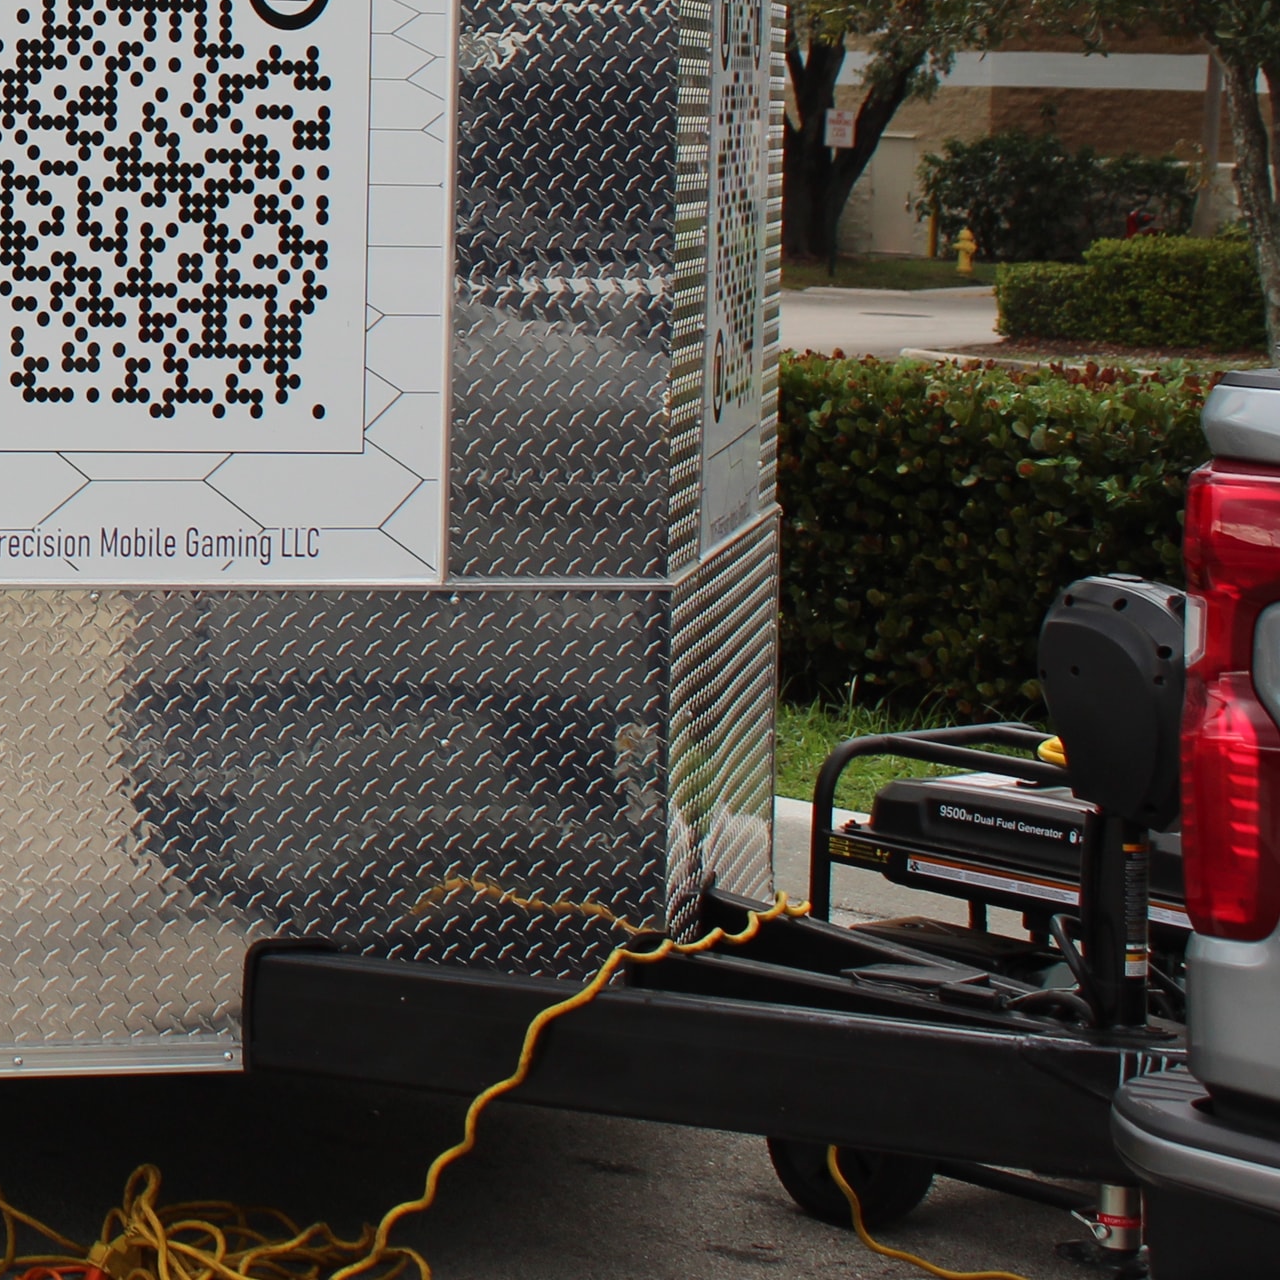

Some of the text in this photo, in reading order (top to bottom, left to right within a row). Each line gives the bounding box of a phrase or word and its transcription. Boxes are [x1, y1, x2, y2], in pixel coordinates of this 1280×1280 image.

[99, 527, 177, 558] Mobile
[185, 527, 272, 565] Gaming
[281, 527, 321, 558] LLC
[973, 813, 994, 826] Dual
[996, 818, 1016, 830] Fuel
[1017, 821, 1064, 839] Generator
